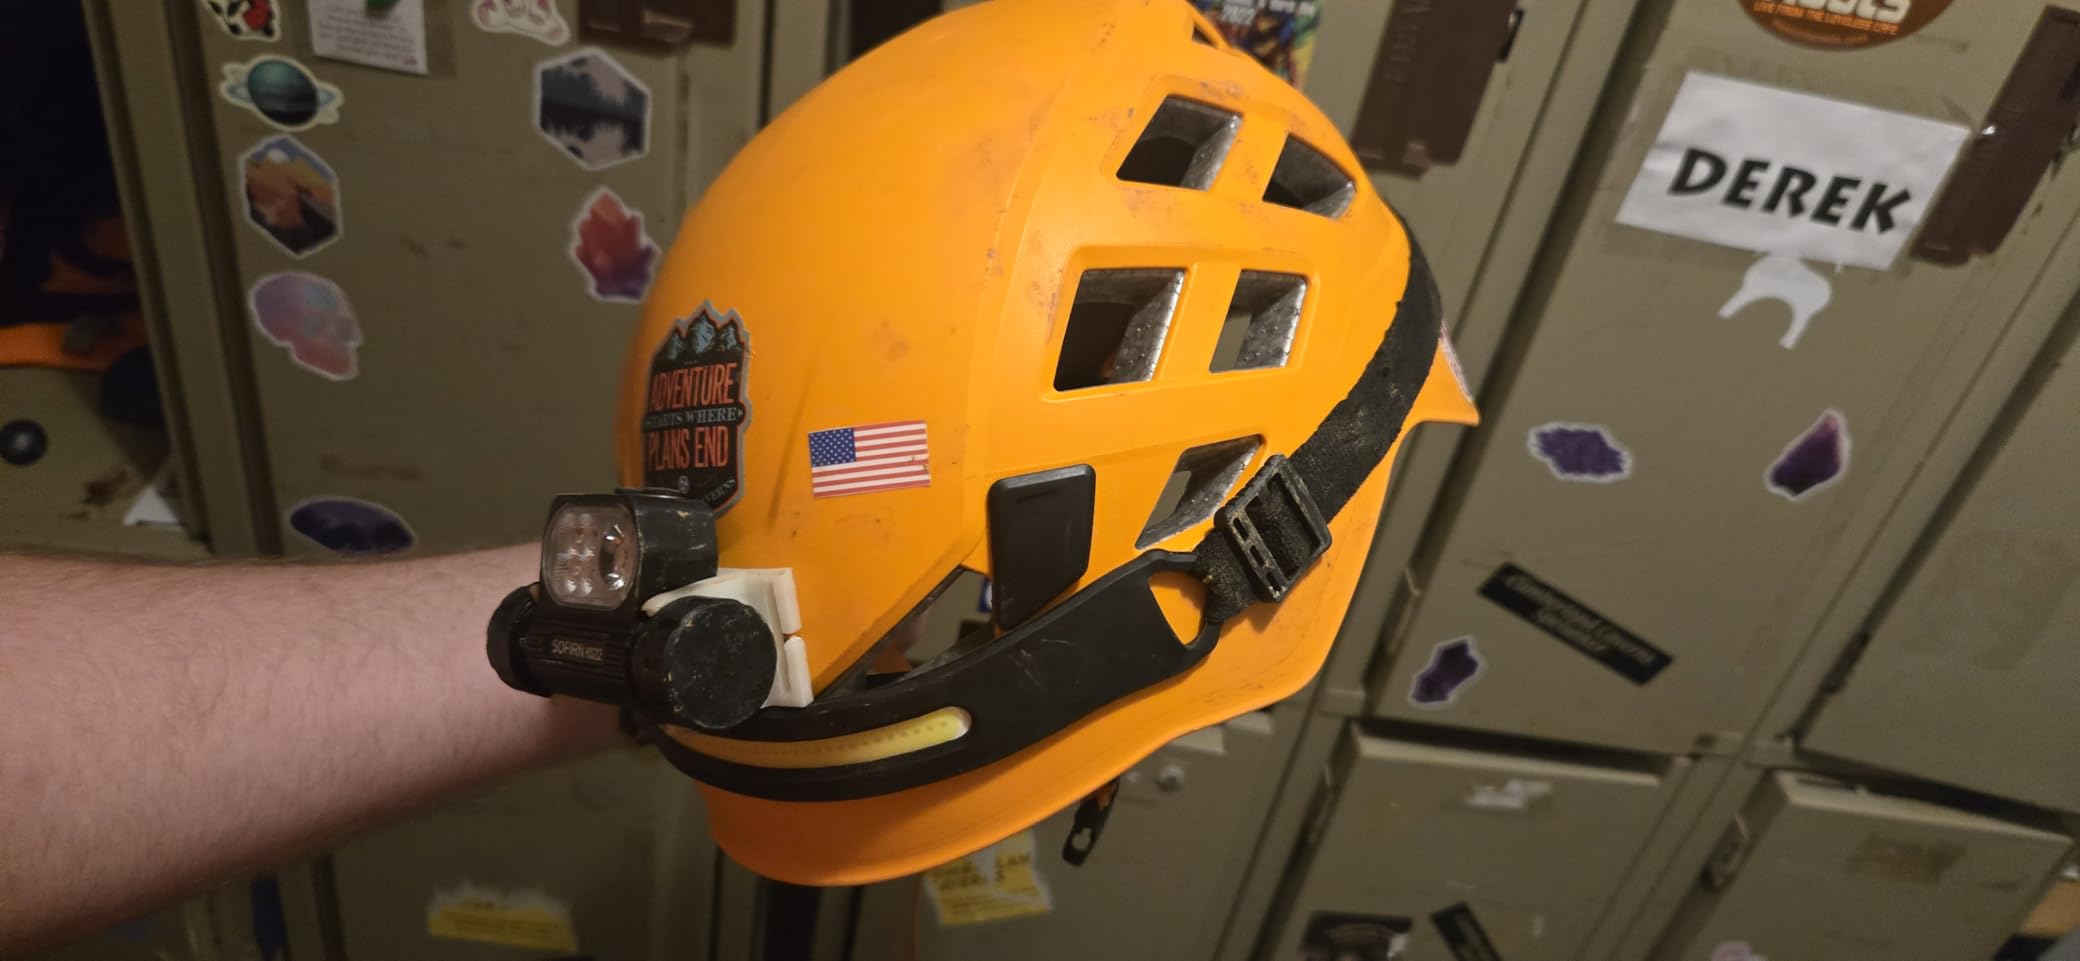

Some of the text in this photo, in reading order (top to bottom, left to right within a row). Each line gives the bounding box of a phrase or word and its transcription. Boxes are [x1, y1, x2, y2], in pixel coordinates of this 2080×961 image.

[1776, 4, 1805, 17] FROM
[1806, 9, 1825, 23] THE
[1667, 147, 1911, 234] DEREK
[651, 363, 737, 411] ADVENTURE
[649, 406, 737, 427] STARTS WHERE
[648, 426, 728, 471] PLANS END
[552, 639, 584, 658] SOFIRN
